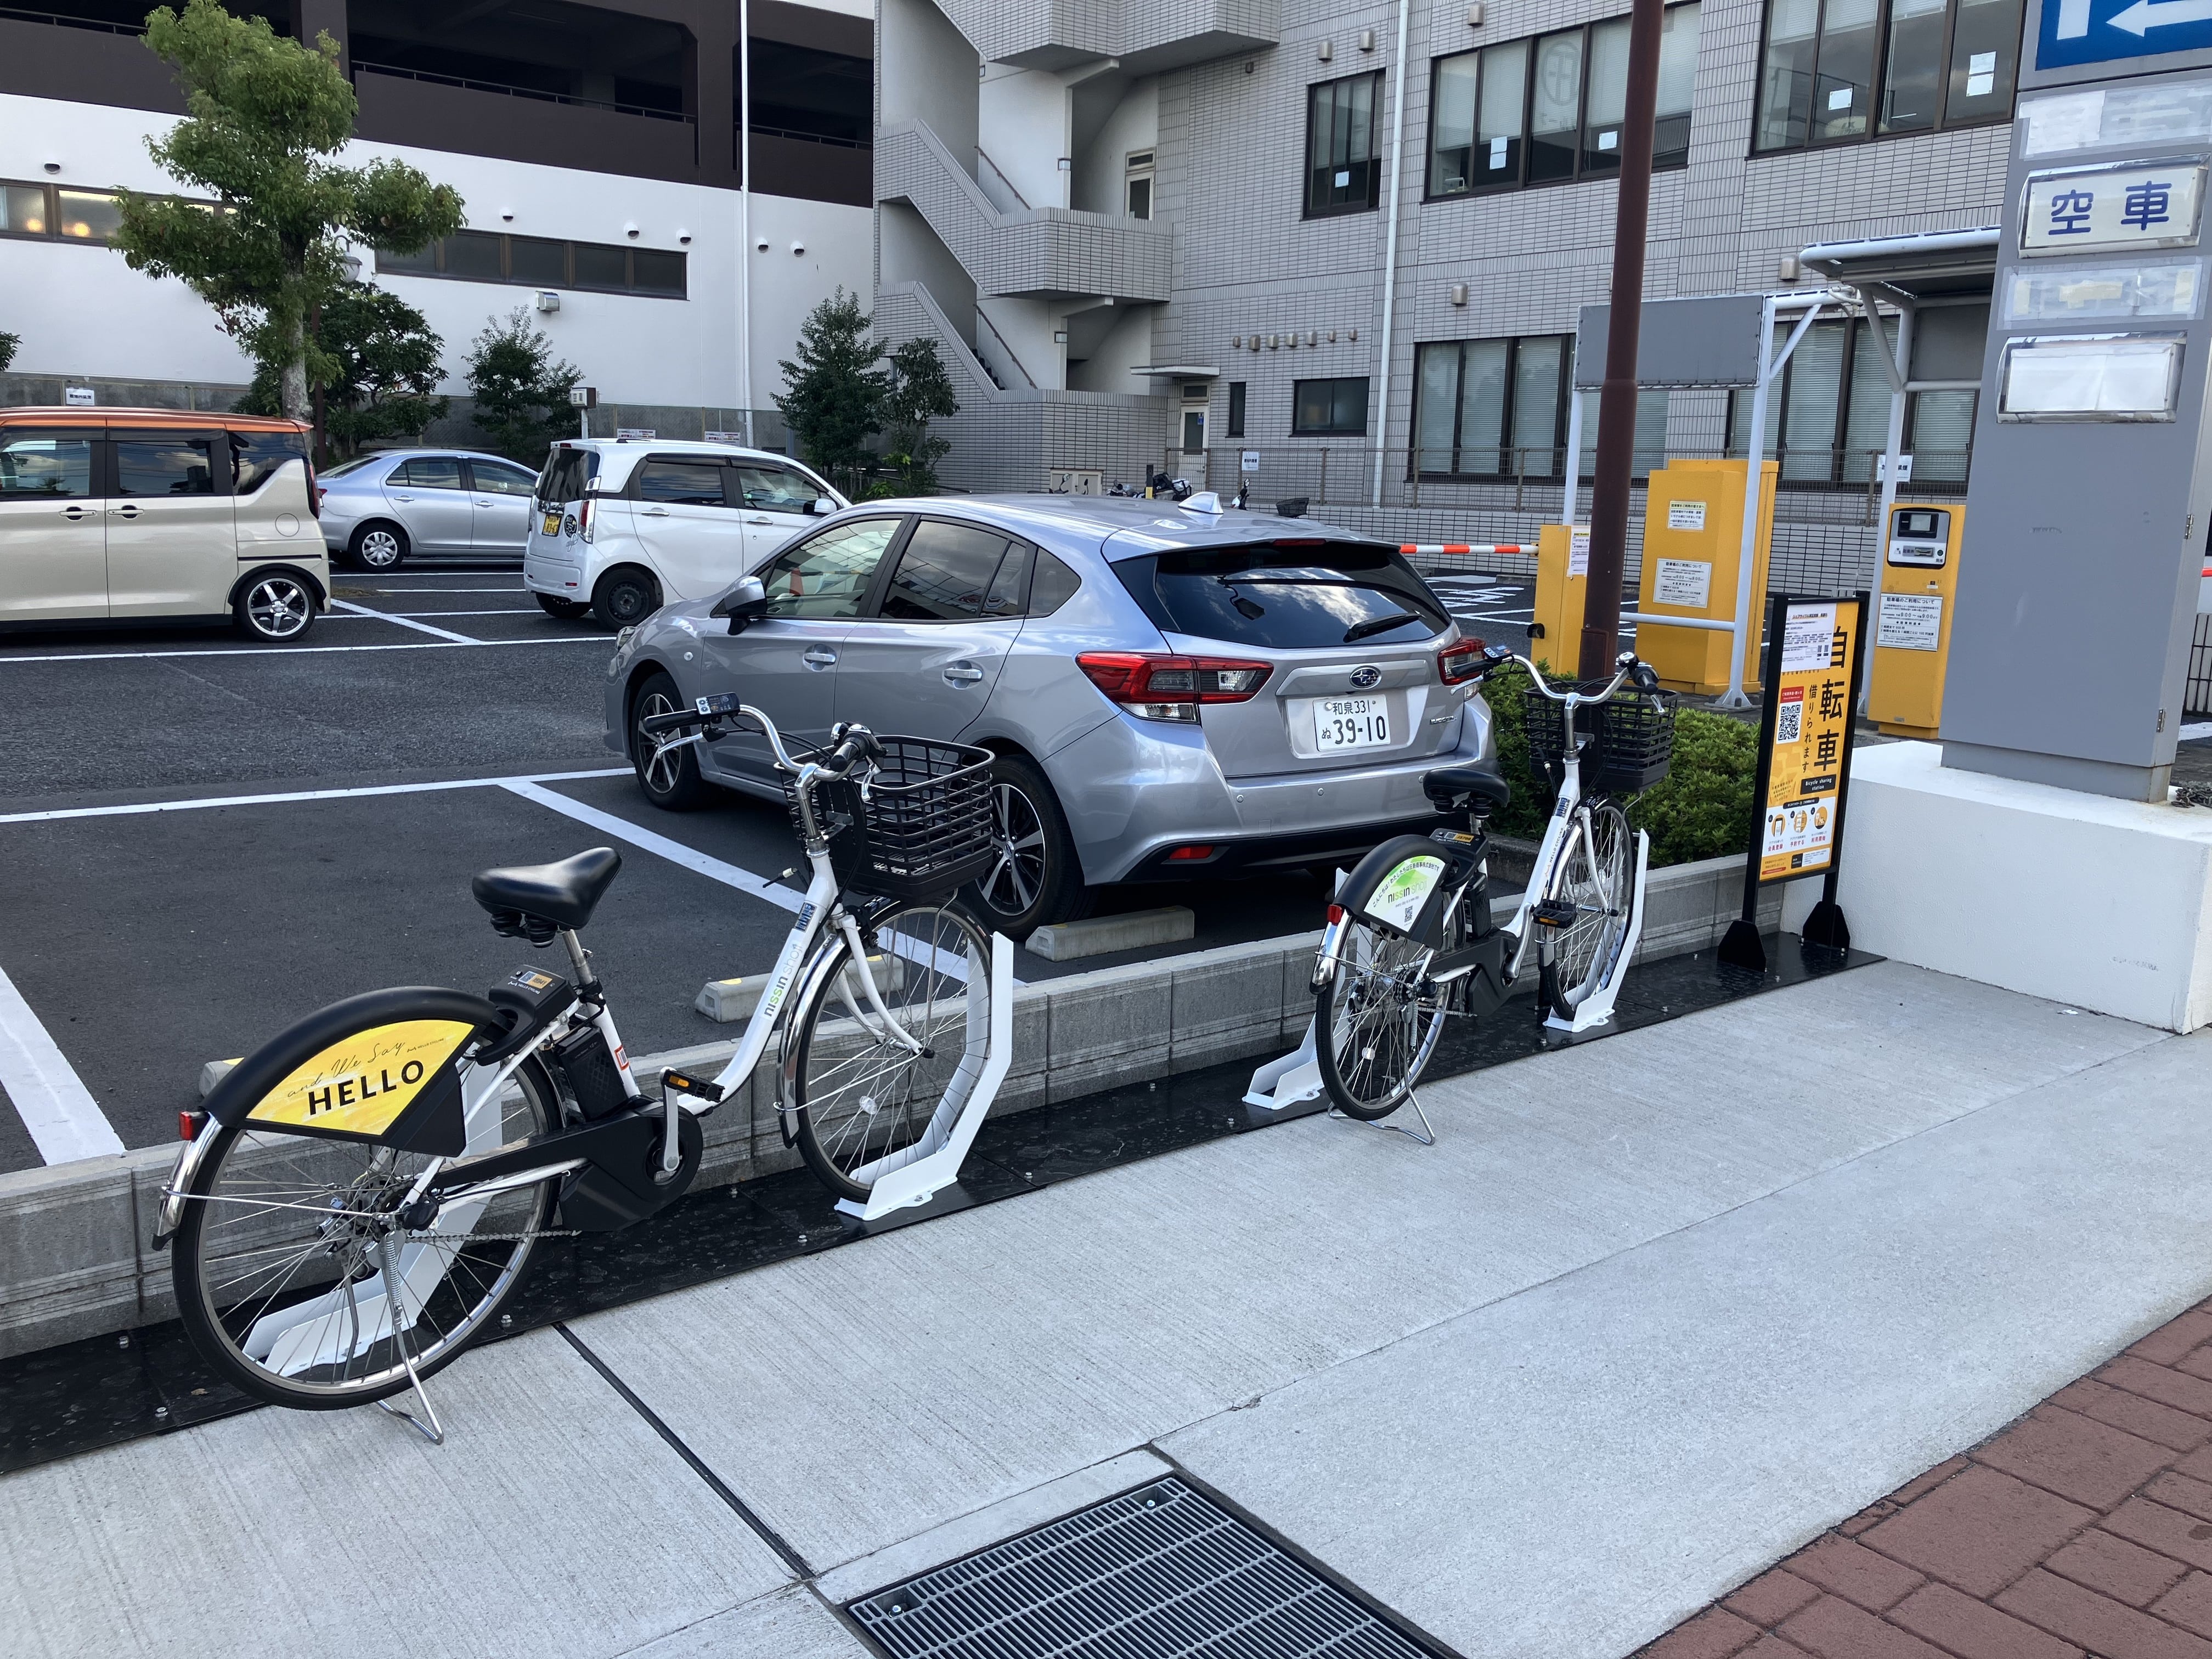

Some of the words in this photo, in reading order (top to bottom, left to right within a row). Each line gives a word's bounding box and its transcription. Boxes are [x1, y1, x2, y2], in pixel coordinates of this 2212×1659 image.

[2049, 180, 2171, 236] 空車
[1814, 625, 1848, 771] 自転車
[1332, 715, 1387, 745] 39-10
[1802, 684, 1818, 774] 借りられます
[1388, 887, 1410, 904] nissin
[764, 976, 788, 1017] nissin
[783, 944, 803, 975] shoji
[287, 1072, 324, 1097] and
[331, 1054, 362, 1078] We
[367, 1042, 406, 1063] Say
[308, 1060, 424, 1116] HELLO
